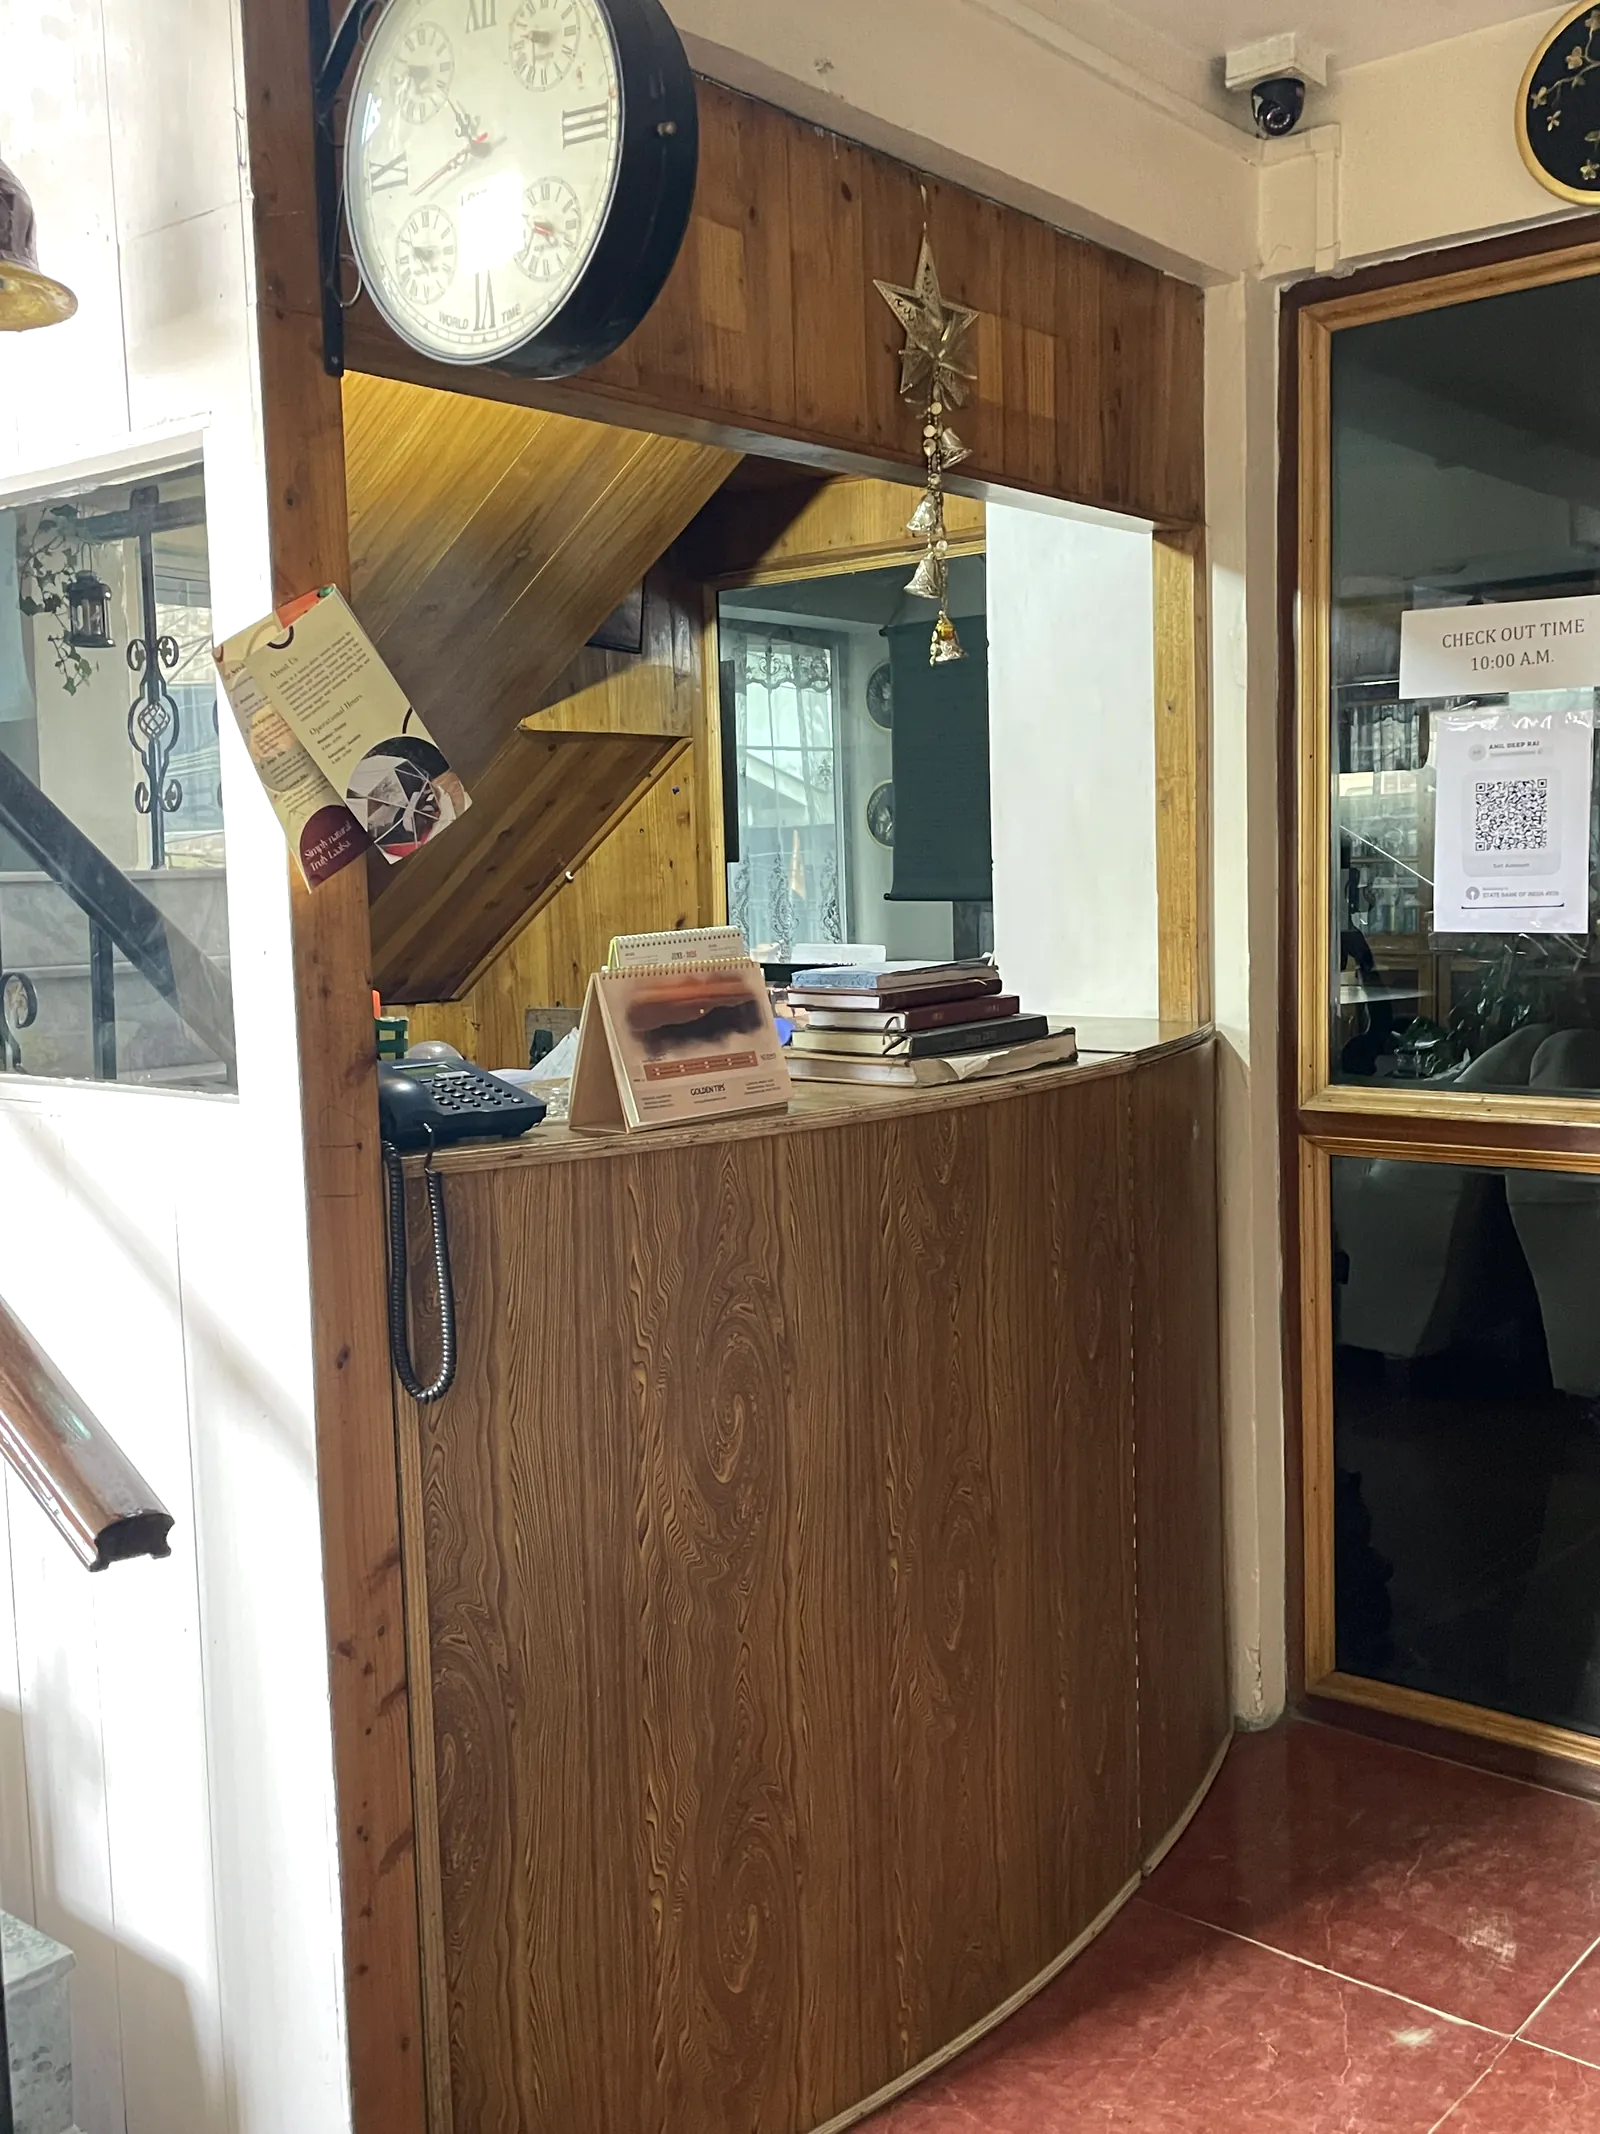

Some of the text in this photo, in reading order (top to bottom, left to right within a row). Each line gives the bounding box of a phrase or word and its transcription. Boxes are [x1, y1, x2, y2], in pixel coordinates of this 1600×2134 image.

[561, 97, 610, 150] III
[501, 302, 522, 323] TIME
[1442, 618, 1585, 649] CHECK OUT TIME
[1471, 649, 1555, 671] 10:00 A.M.
[270, 663, 290, 681] About
[309, 705, 345, 735] Operational
[343, 694, 363, 710] Hours
[1506, 741, 1526, 749] DEEP
[304, 820, 353, 861] Simply natural
[310, 854, 329, 872] Truly
